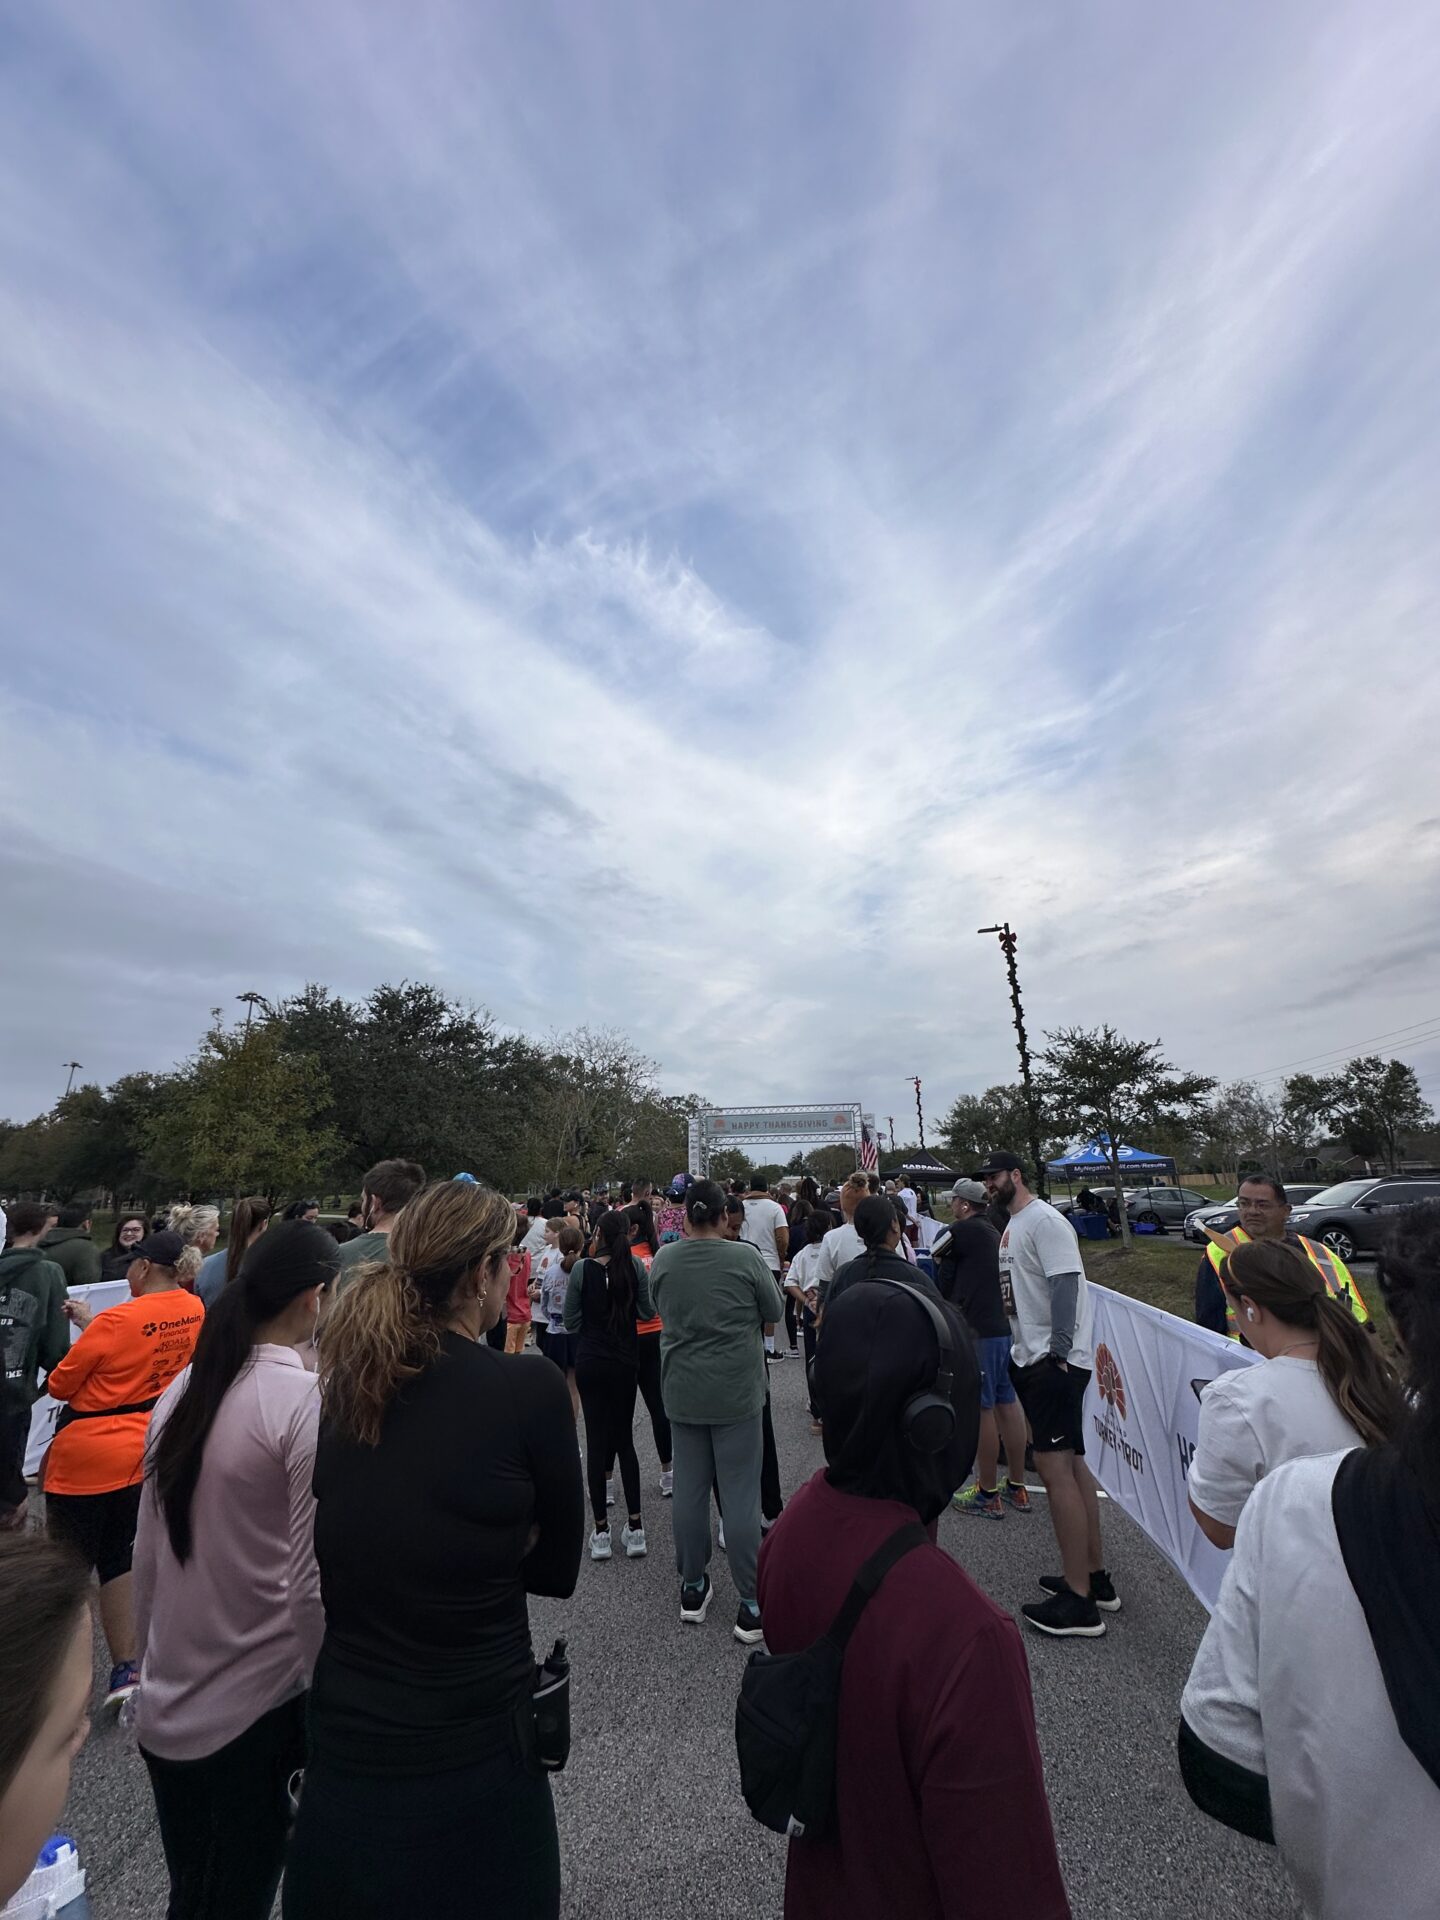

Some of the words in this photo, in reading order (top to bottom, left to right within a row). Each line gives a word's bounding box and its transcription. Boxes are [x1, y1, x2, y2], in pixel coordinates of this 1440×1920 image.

[732, 1121, 760, 1130] HAPPY
[763, 1120, 828, 1129] THANKSGIVING
[159, 1314, 201, 1331] OneMain
